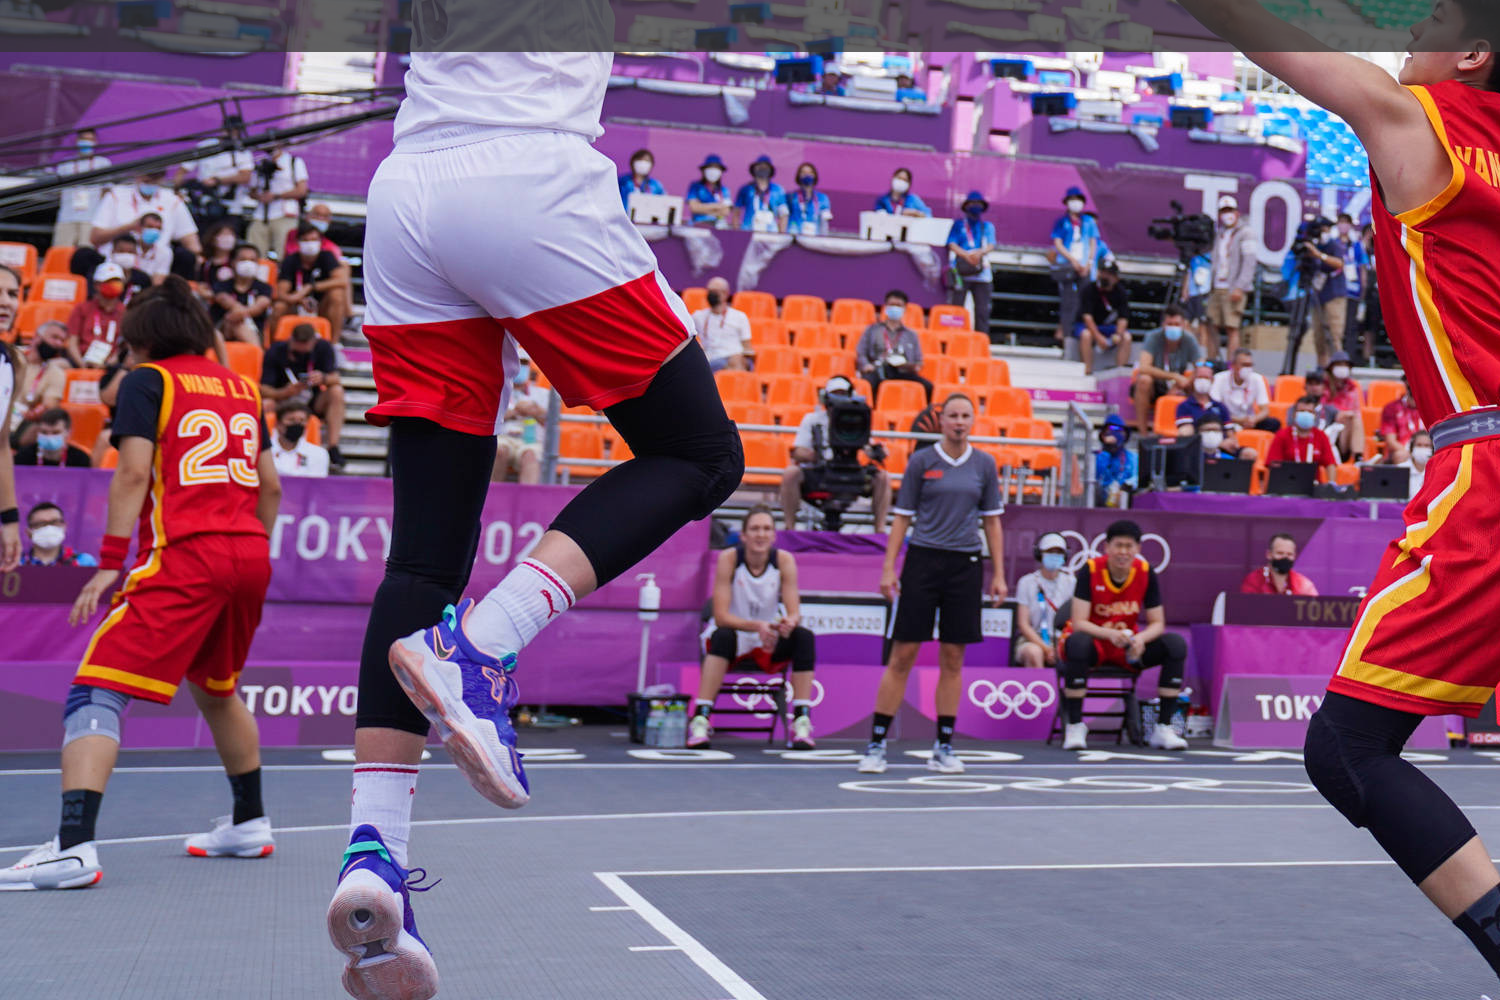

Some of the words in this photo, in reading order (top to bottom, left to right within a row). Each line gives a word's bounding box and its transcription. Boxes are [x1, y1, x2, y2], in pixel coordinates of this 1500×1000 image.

[176, 373, 226, 398] WANG
[177, 409, 260, 487] 23
[1095, 600, 1139, 617] CHINA
[983, 619, 1009, 633] 020
